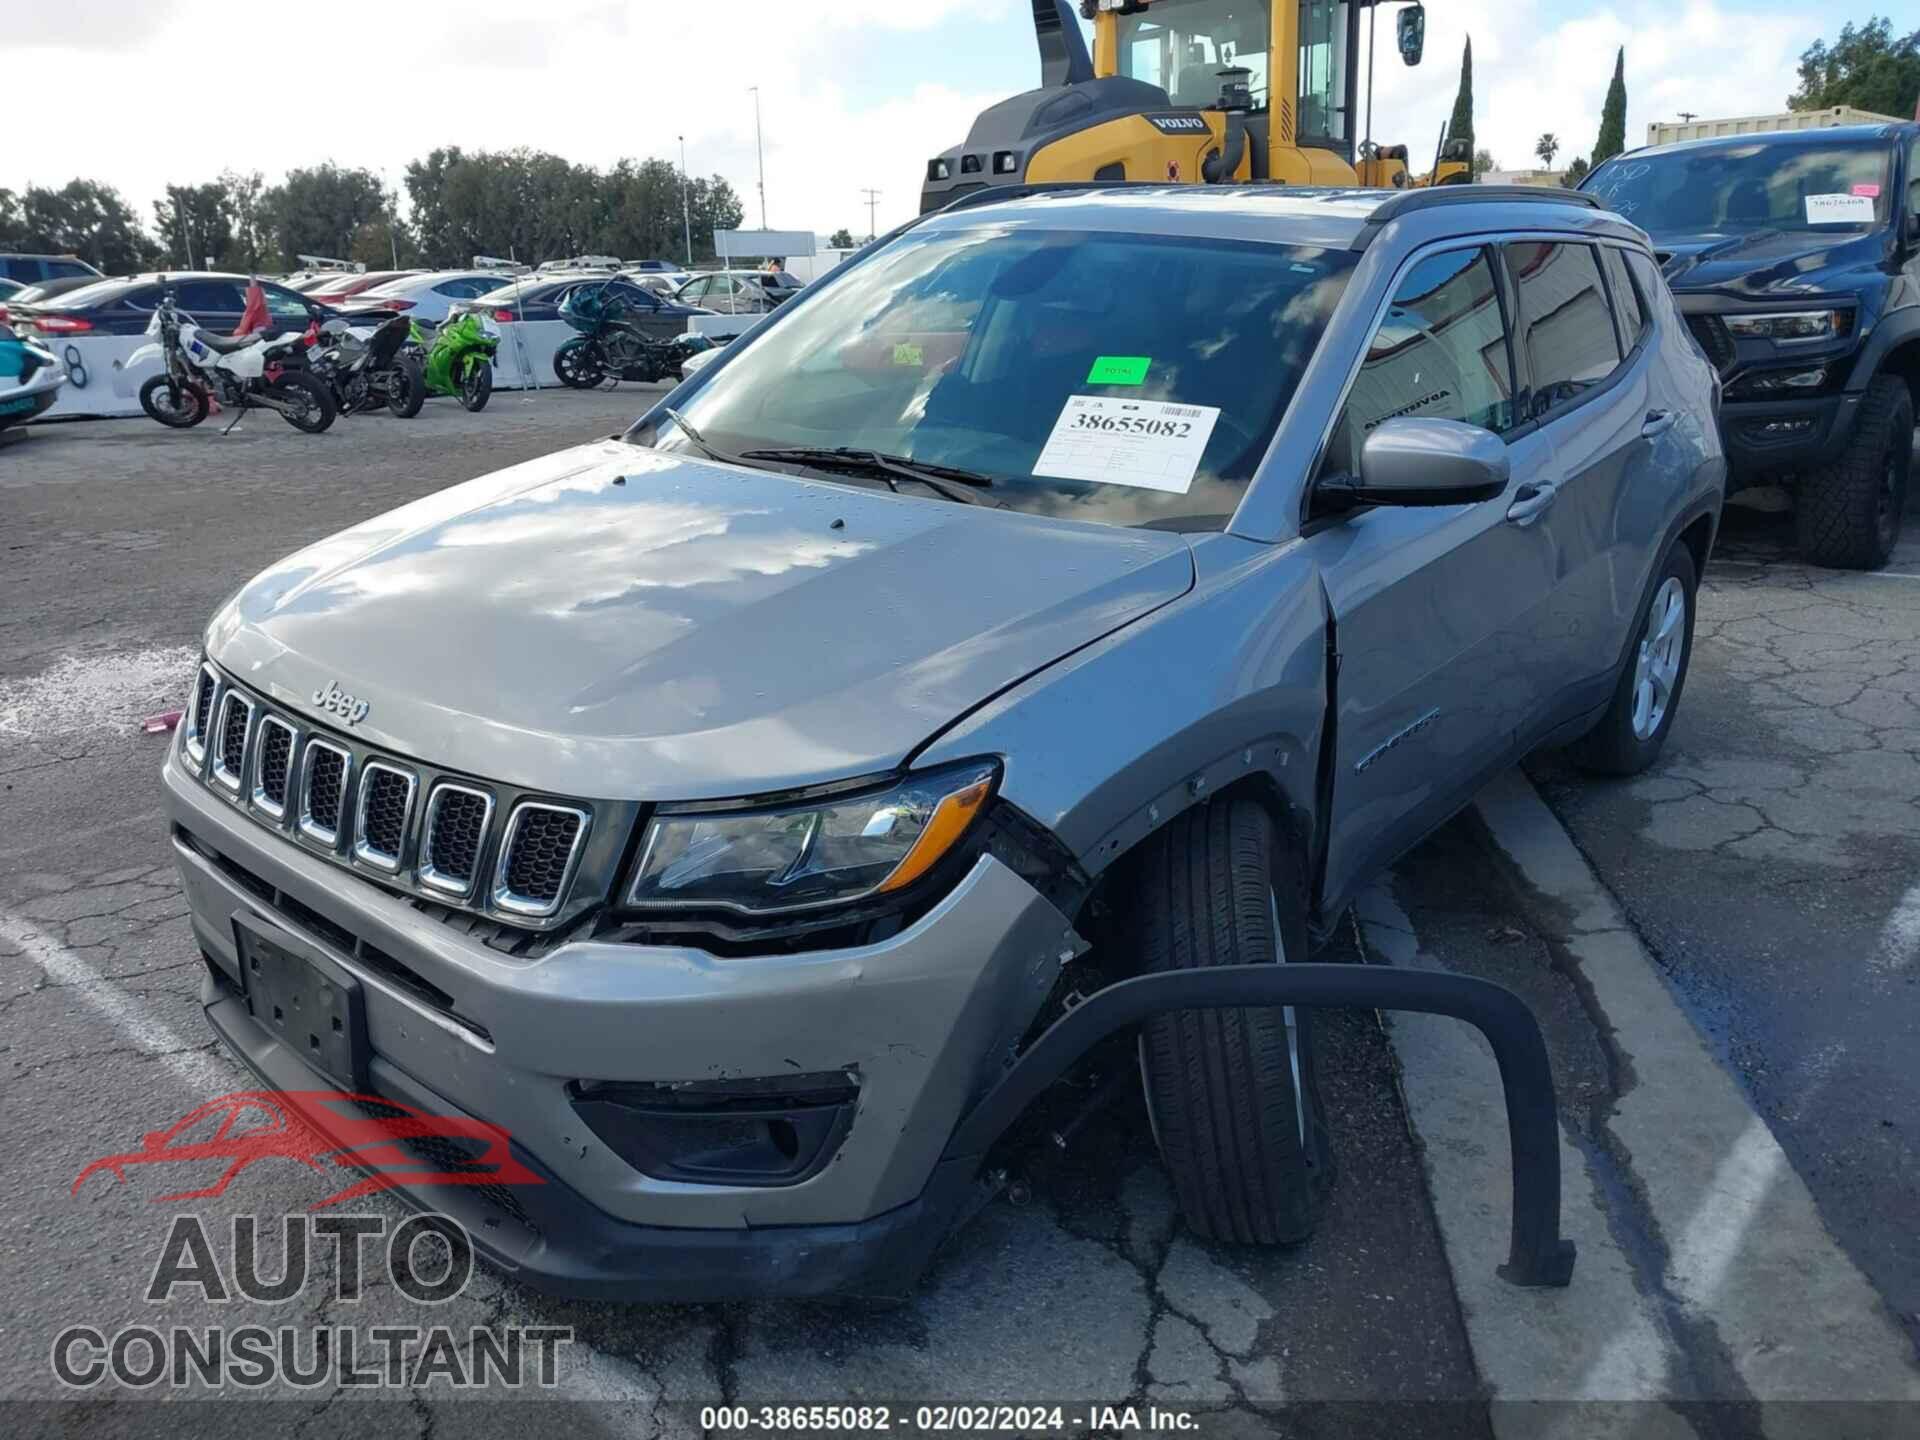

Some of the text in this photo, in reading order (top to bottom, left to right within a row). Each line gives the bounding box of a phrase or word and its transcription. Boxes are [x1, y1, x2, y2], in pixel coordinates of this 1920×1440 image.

[1152, 118, 1204, 129] VOLVO
[64, 344, 88, 389] 8
[1070, 412, 1192, 439] 38655082
[311, 679, 370, 726] Jeep
